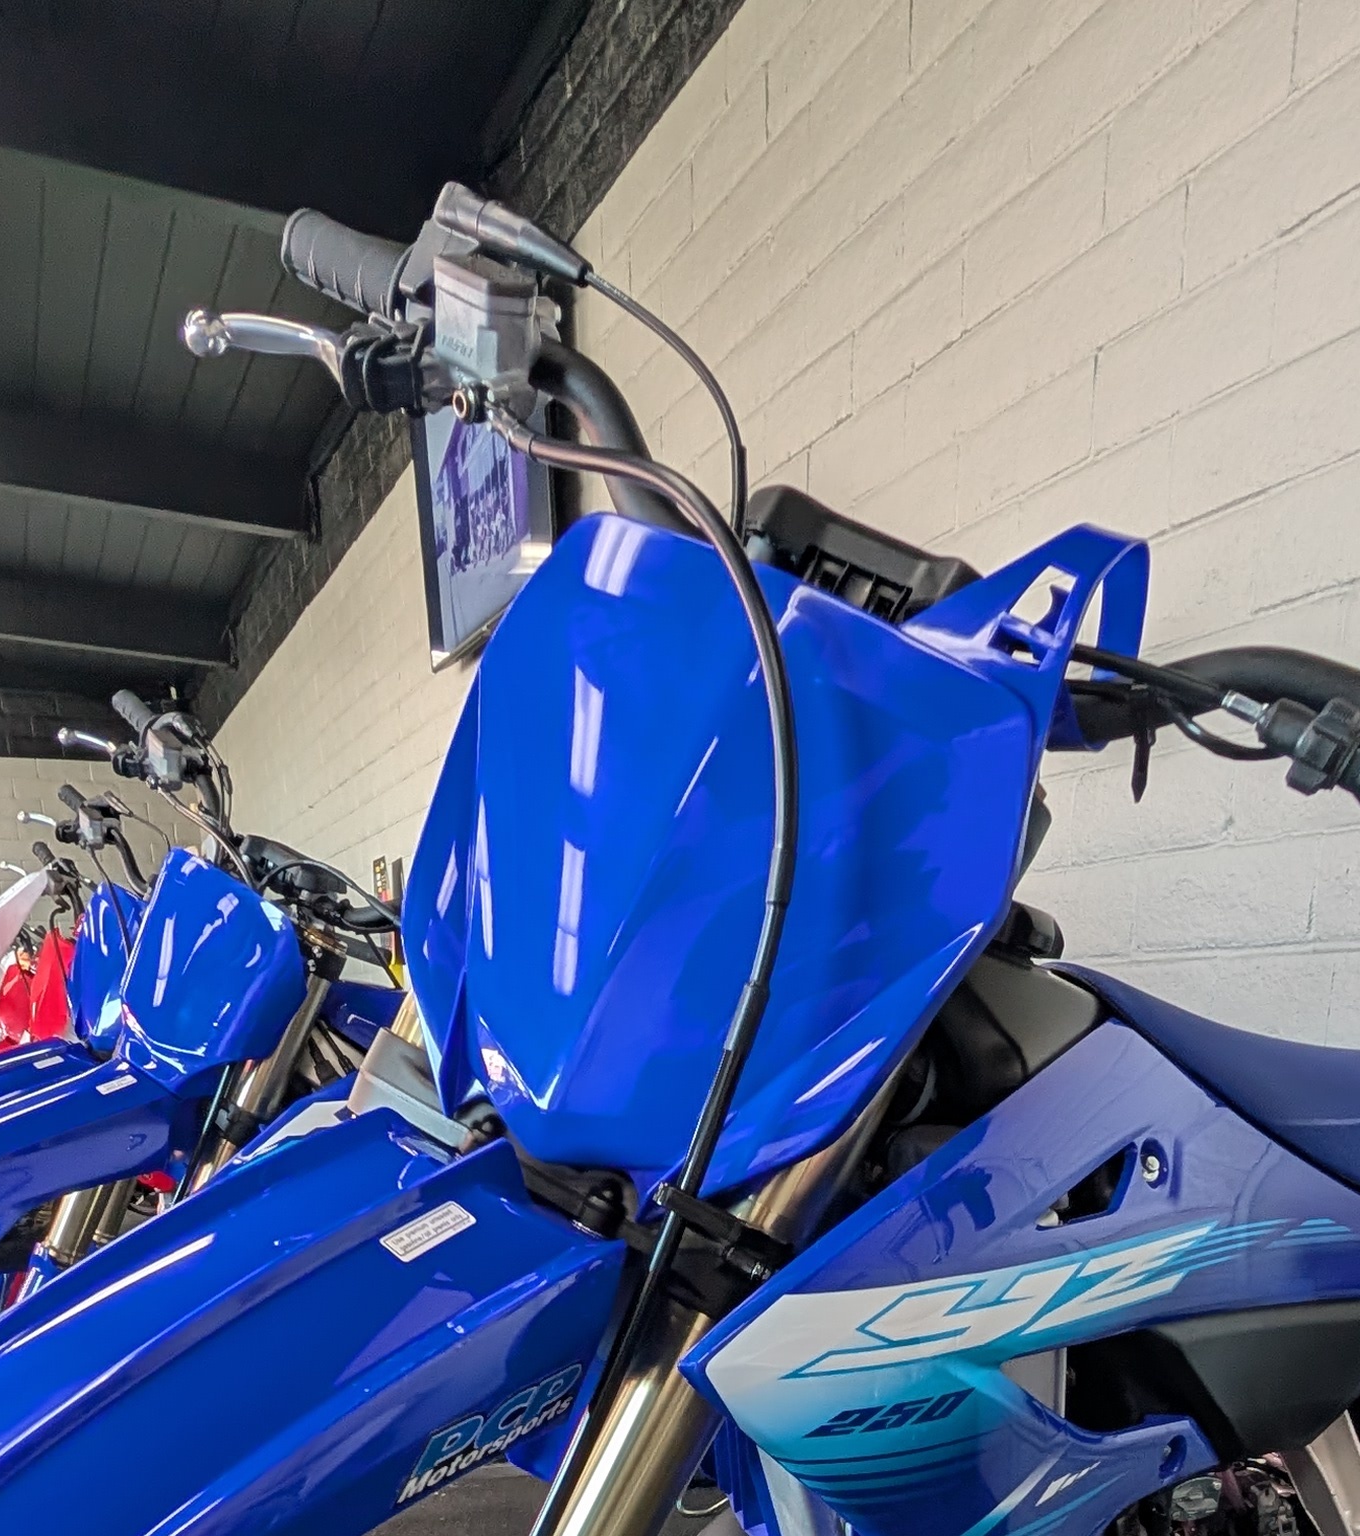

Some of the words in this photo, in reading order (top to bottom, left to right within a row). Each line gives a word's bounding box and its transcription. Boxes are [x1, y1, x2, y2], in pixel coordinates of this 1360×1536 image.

[779, 1220, 1220, 1380] YZ
[396, 1396, 574, 1503] Motorsports
[411, 1363, 583, 1478] PCP
[802, 1387, 976, 1439] 250
